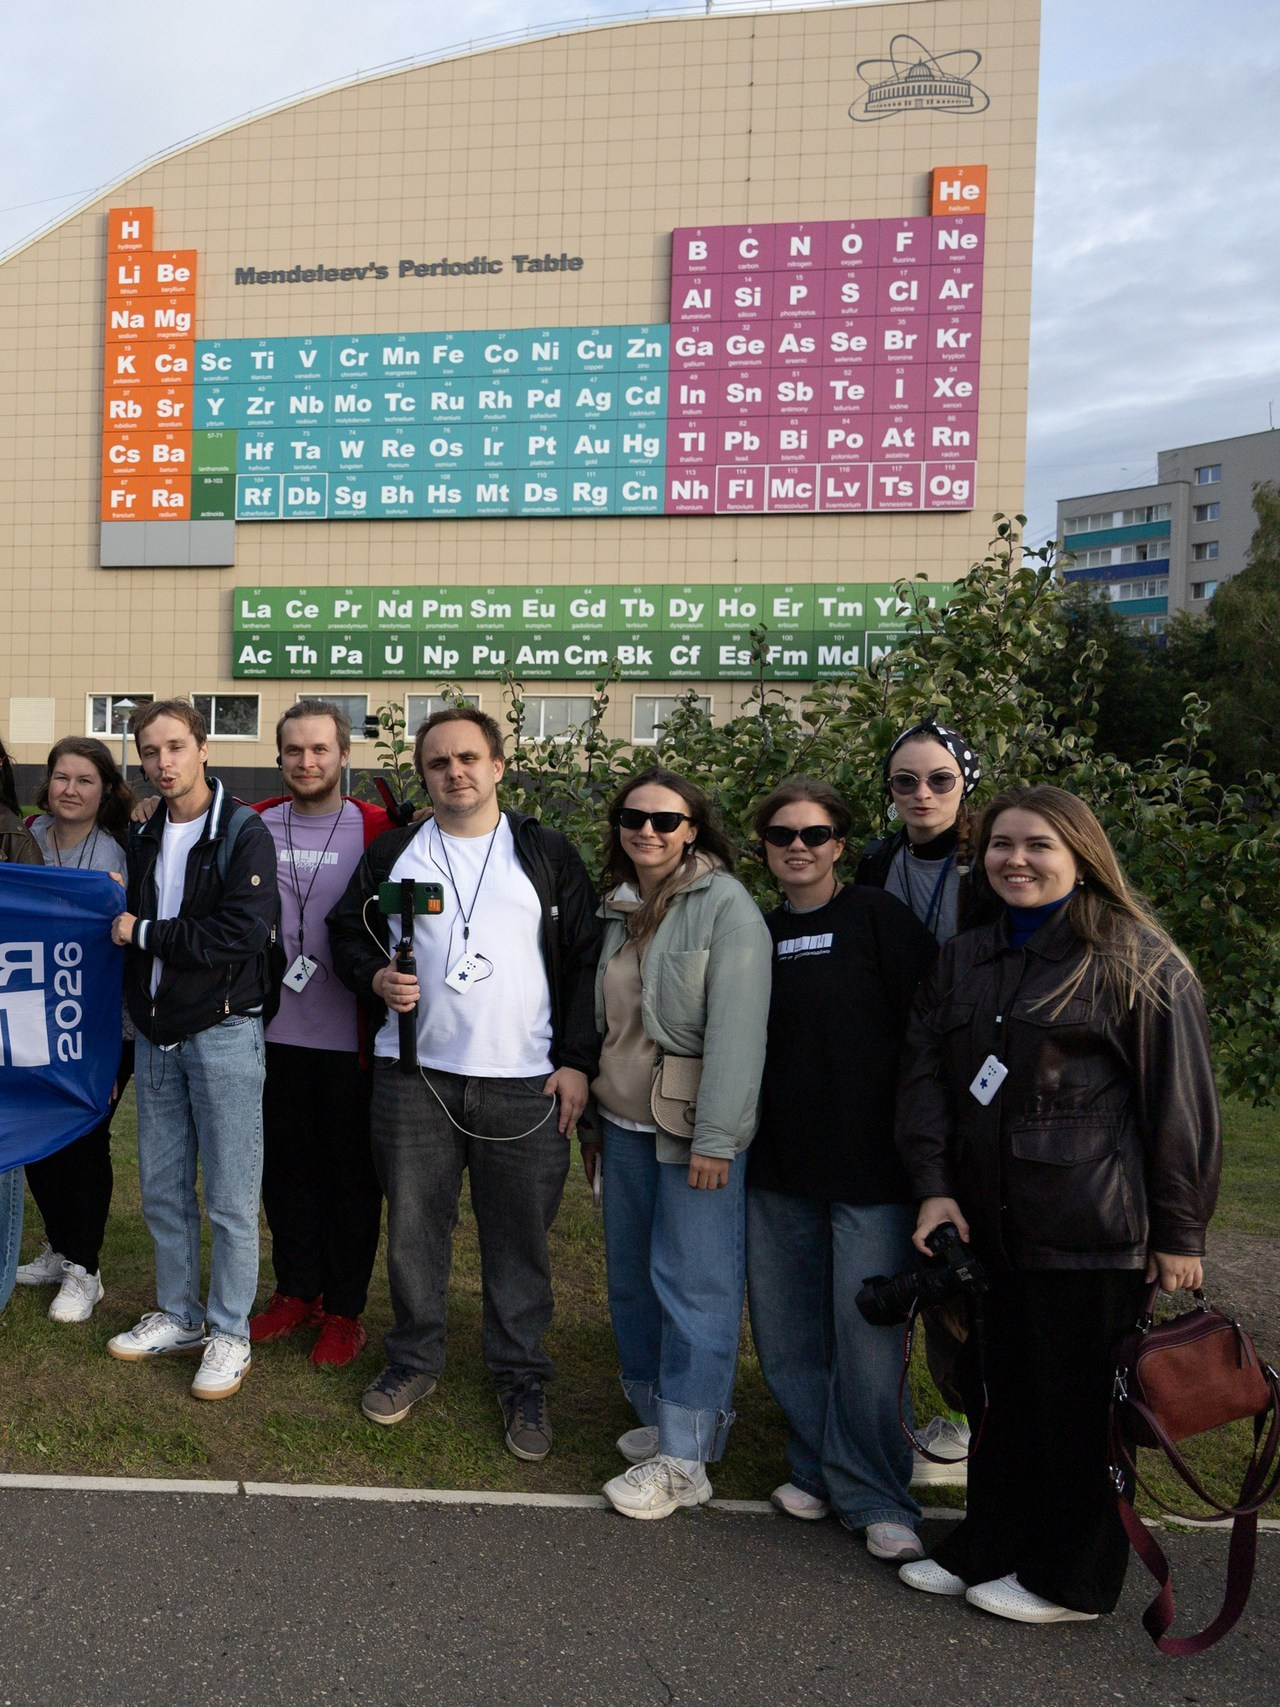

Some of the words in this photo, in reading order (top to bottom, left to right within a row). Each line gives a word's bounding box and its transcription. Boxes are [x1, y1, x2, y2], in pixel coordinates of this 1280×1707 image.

[940, 181, 980, 201] He
[122, 221, 139, 238] H
[739, 238, 759, 258] C
[790, 236, 811, 256] N
[842, 234, 863, 254] O
[896, 232, 914, 252] F
[938, 229, 978, 250] Ne
[688, 240, 708, 260] B
[119, 266, 140, 284] Li
[158, 264, 190, 282] Be
[235, 262, 389, 285] Mendeleev's
[399, 256, 503, 278] Periodic
[512, 253, 584, 273] Table
[682, 288, 711, 309] Al
[734, 287, 761, 307] Si
[790, 285, 808, 305] P
[841, 282, 860, 303] S
[889, 280, 918, 301] Cl
[938, 279, 974, 299] Ar
[112, 311, 144, 328] Na
[155, 309, 190, 331] Mg
[675, 337, 714, 357] Ga
[726, 335, 765, 355] Ge
[778, 333, 816, 353] As
[830, 332, 868, 352] Se
[884, 330, 918, 350] Br
[936, 328, 972, 348] Kr
[340, 348, 368, 367] Cr
[382, 346, 420, 365] Mn
[433, 345, 464, 364] Fe
[484, 344, 519, 363] Co
[532, 342, 559, 361] Ni
[577, 340, 612, 360] Cu
[626, 338, 662, 358] Zn
[118, 356, 135, 373] K
[156, 354, 187, 372] Ca
[201, 352, 232, 371] Sc
[250, 351, 274, 369] Ti
[299, 350, 317, 368] V
[625, 386, 661, 406] Cd
[680, 385, 706, 404] In
[726, 383, 762, 403] Sn
[777, 381, 814, 402] Sb
[830, 380, 865, 400] Te
[895, 378, 904, 398] I
[933, 377, 973, 398] Xe
[207, 398, 224, 416] Y
[246, 397, 275, 415] Zr
[290, 396, 324, 414] Nb
[334, 394, 372, 412] Mo
[384, 393, 416, 412] Tc
[431, 392, 464, 410] Ru
[478, 390, 512, 409] Rh
[527, 389, 561, 408] Pd
[576, 388, 611, 411] Ag
[110, 400, 142, 418] Rb
[158, 400, 184, 417] Sr
[528, 436, 557, 455] Pt
[574, 435, 610, 454] Au
[678, 432, 705, 452] Tl
[724, 431, 760, 451] Pb
[780, 429, 808, 450] Bi
[827, 429, 864, 449] Po
[881, 428, 915, 448] At
[932, 426, 970, 446] Rn
[110, 446, 140, 463] Cs
[153, 445, 184, 462] Ba
[245, 442, 274, 460] Hf
[290, 441, 321, 459] Ta
[340, 440, 364, 458] W
[382, 439, 415, 458] Re
[429, 438, 463, 457] Os
[484, 437, 504, 456] Ir
[623, 434, 660, 458] Hg
[381, 485, 414, 504] Bh
[428, 484, 462, 504] Hs
[476, 484, 510, 502] Mt
[524, 483, 558, 502] Ds
[573, 482, 608, 506] Rg
[622, 481, 658, 501] Cn
[671, 480, 709, 500] Nh
[728, 479, 753, 499] Fl
[771, 478, 812, 498] Mc
[826, 477, 861, 498] Lv
[880, 476, 913, 496] Ts
[930, 475, 970, 501] Og
[112, 490, 136, 507] Fr
[152, 490, 184, 507] Ra
[244, 487, 272, 506] Rf
[288, 487, 321, 505] Db
[335, 486, 366, 510] Sg
[242, 600, 271, 618] La
[286, 600, 319, 618] Ce
[334, 600, 362, 618] Pr
[378, 600, 413, 618] Nd
[422, 600, 463, 618] Pm
[470, 599, 512, 618] Sm
[522, 598, 556, 618] Eu
[570, 598, 606, 618] Gd
[620, 598, 655, 618] Tb
[669, 598, 704, 622] Dy
[718, 598, 756, 617] Ho
[773, 598, 804, 617] Er
[818, 597, 863, 616] Tm
[238, 645, 272, 664] Ac
[285, 645, 317, 664] Th
[331, 646, 362, 664] Pa
[385, 646, 403, 664] U
[424, 646, 459, 669] Np
[472, 646, 505, 664] Pu
[515, 645, 559, 664] Am
[564, 645, 608, 665] Cm
[617, 646, 653, 665] Bk
[670, 645, 701, 665] Cf
[719, 646, 751, 665] Es
[766, 646, 808, 665] Fm
[818, 646, 859, 665] Md
[53, 941, 84, 1062] 2026
